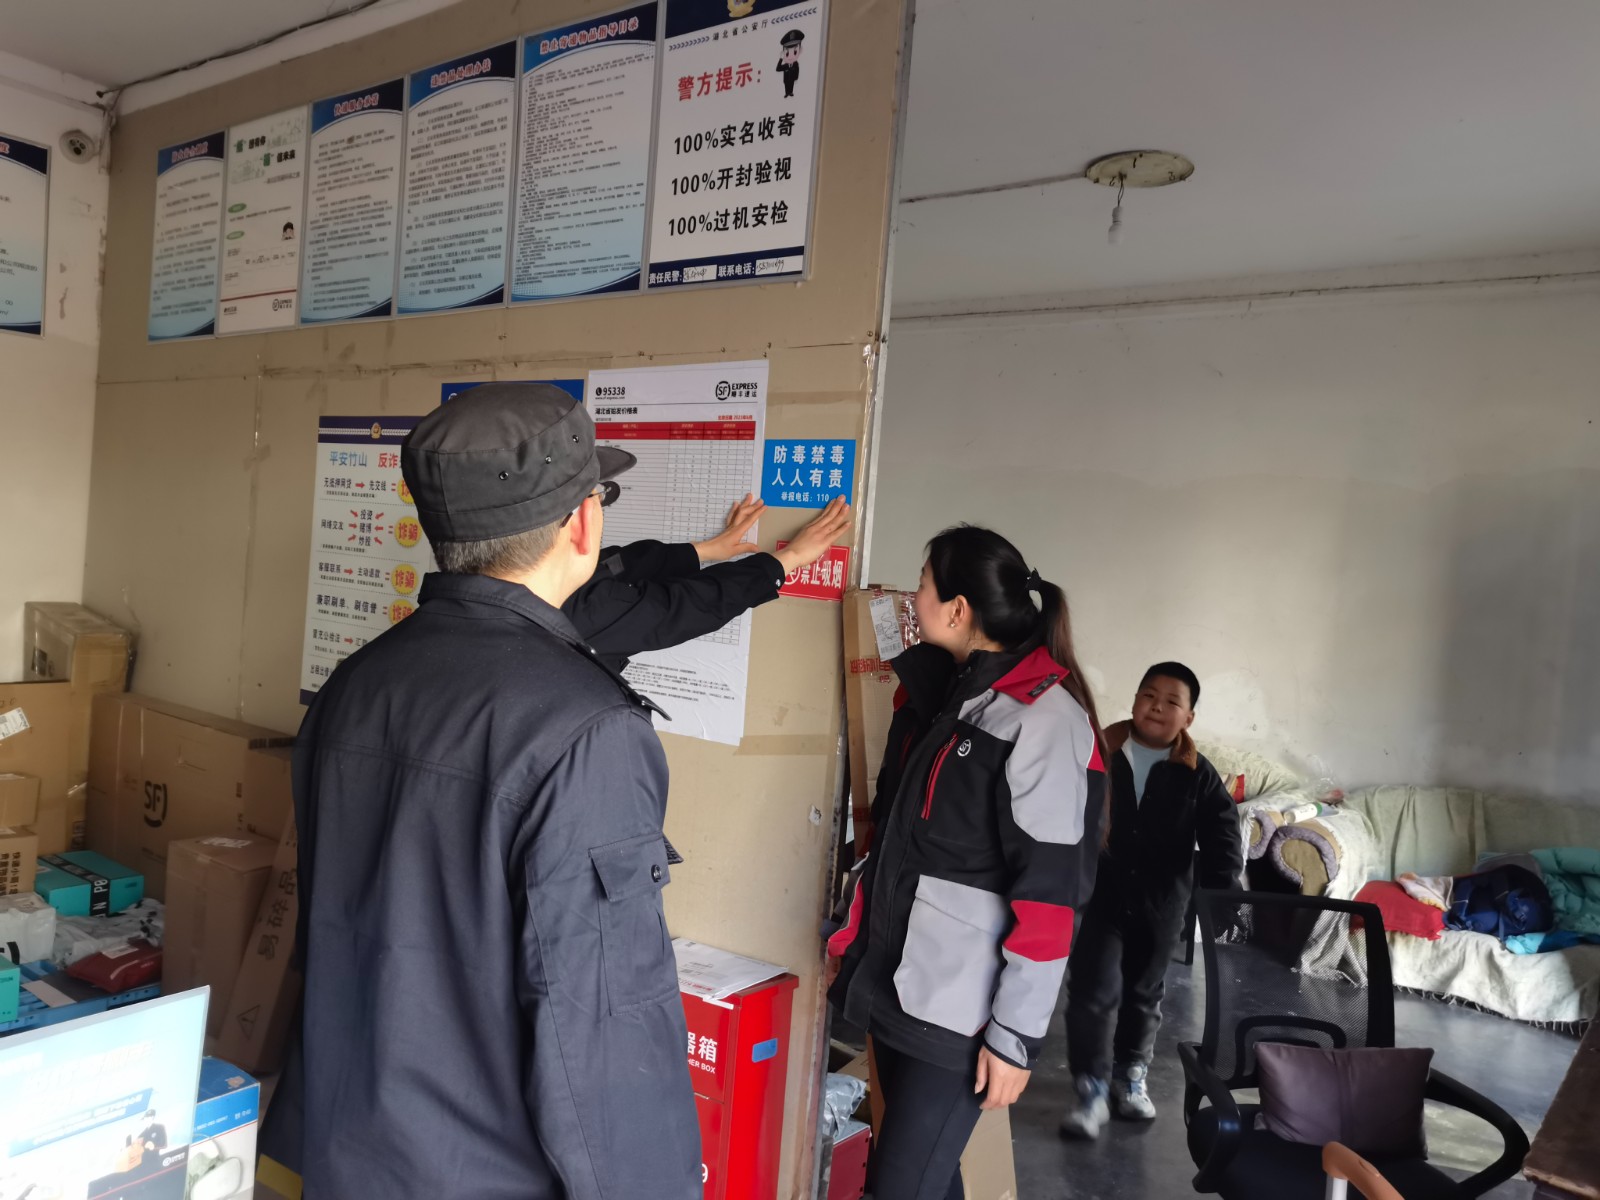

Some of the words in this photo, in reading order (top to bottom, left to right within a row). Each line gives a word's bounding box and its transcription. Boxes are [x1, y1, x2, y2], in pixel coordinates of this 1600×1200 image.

[712, 20, 768, 41] 湖北省公安厅
[678, 62, 762, 101] 警方提示：
[674, 112, 796, 155] 100%实名收寄
[671, 157, 792, 195] 100%开封验视
[668, 200, 788, 236] 100%过机安检
[602, 386, 626, 396] 95338
[731, 382, 758, 390] EXPRESS
[731, 390, 757, 398] 顺丰速运
[330, 451, 368, 467] 平安竹山
[378, 452, 401, 469] 反诈
[774, 445, 844, 465] 防毒禁毒
[772, 468, 843, 489] 人人有责
[360, 509, 373, 520] 投资
[321, 519, 344, 530] 网络交友
[359, 522, 372, 533] 赌博
[398, 522, 418, 541] 诈骗
[357, 567, 380, 578] 主动退款
[395, 569, 415, 588] 诈骗
[701, 1062, 716, 1074] BOX
